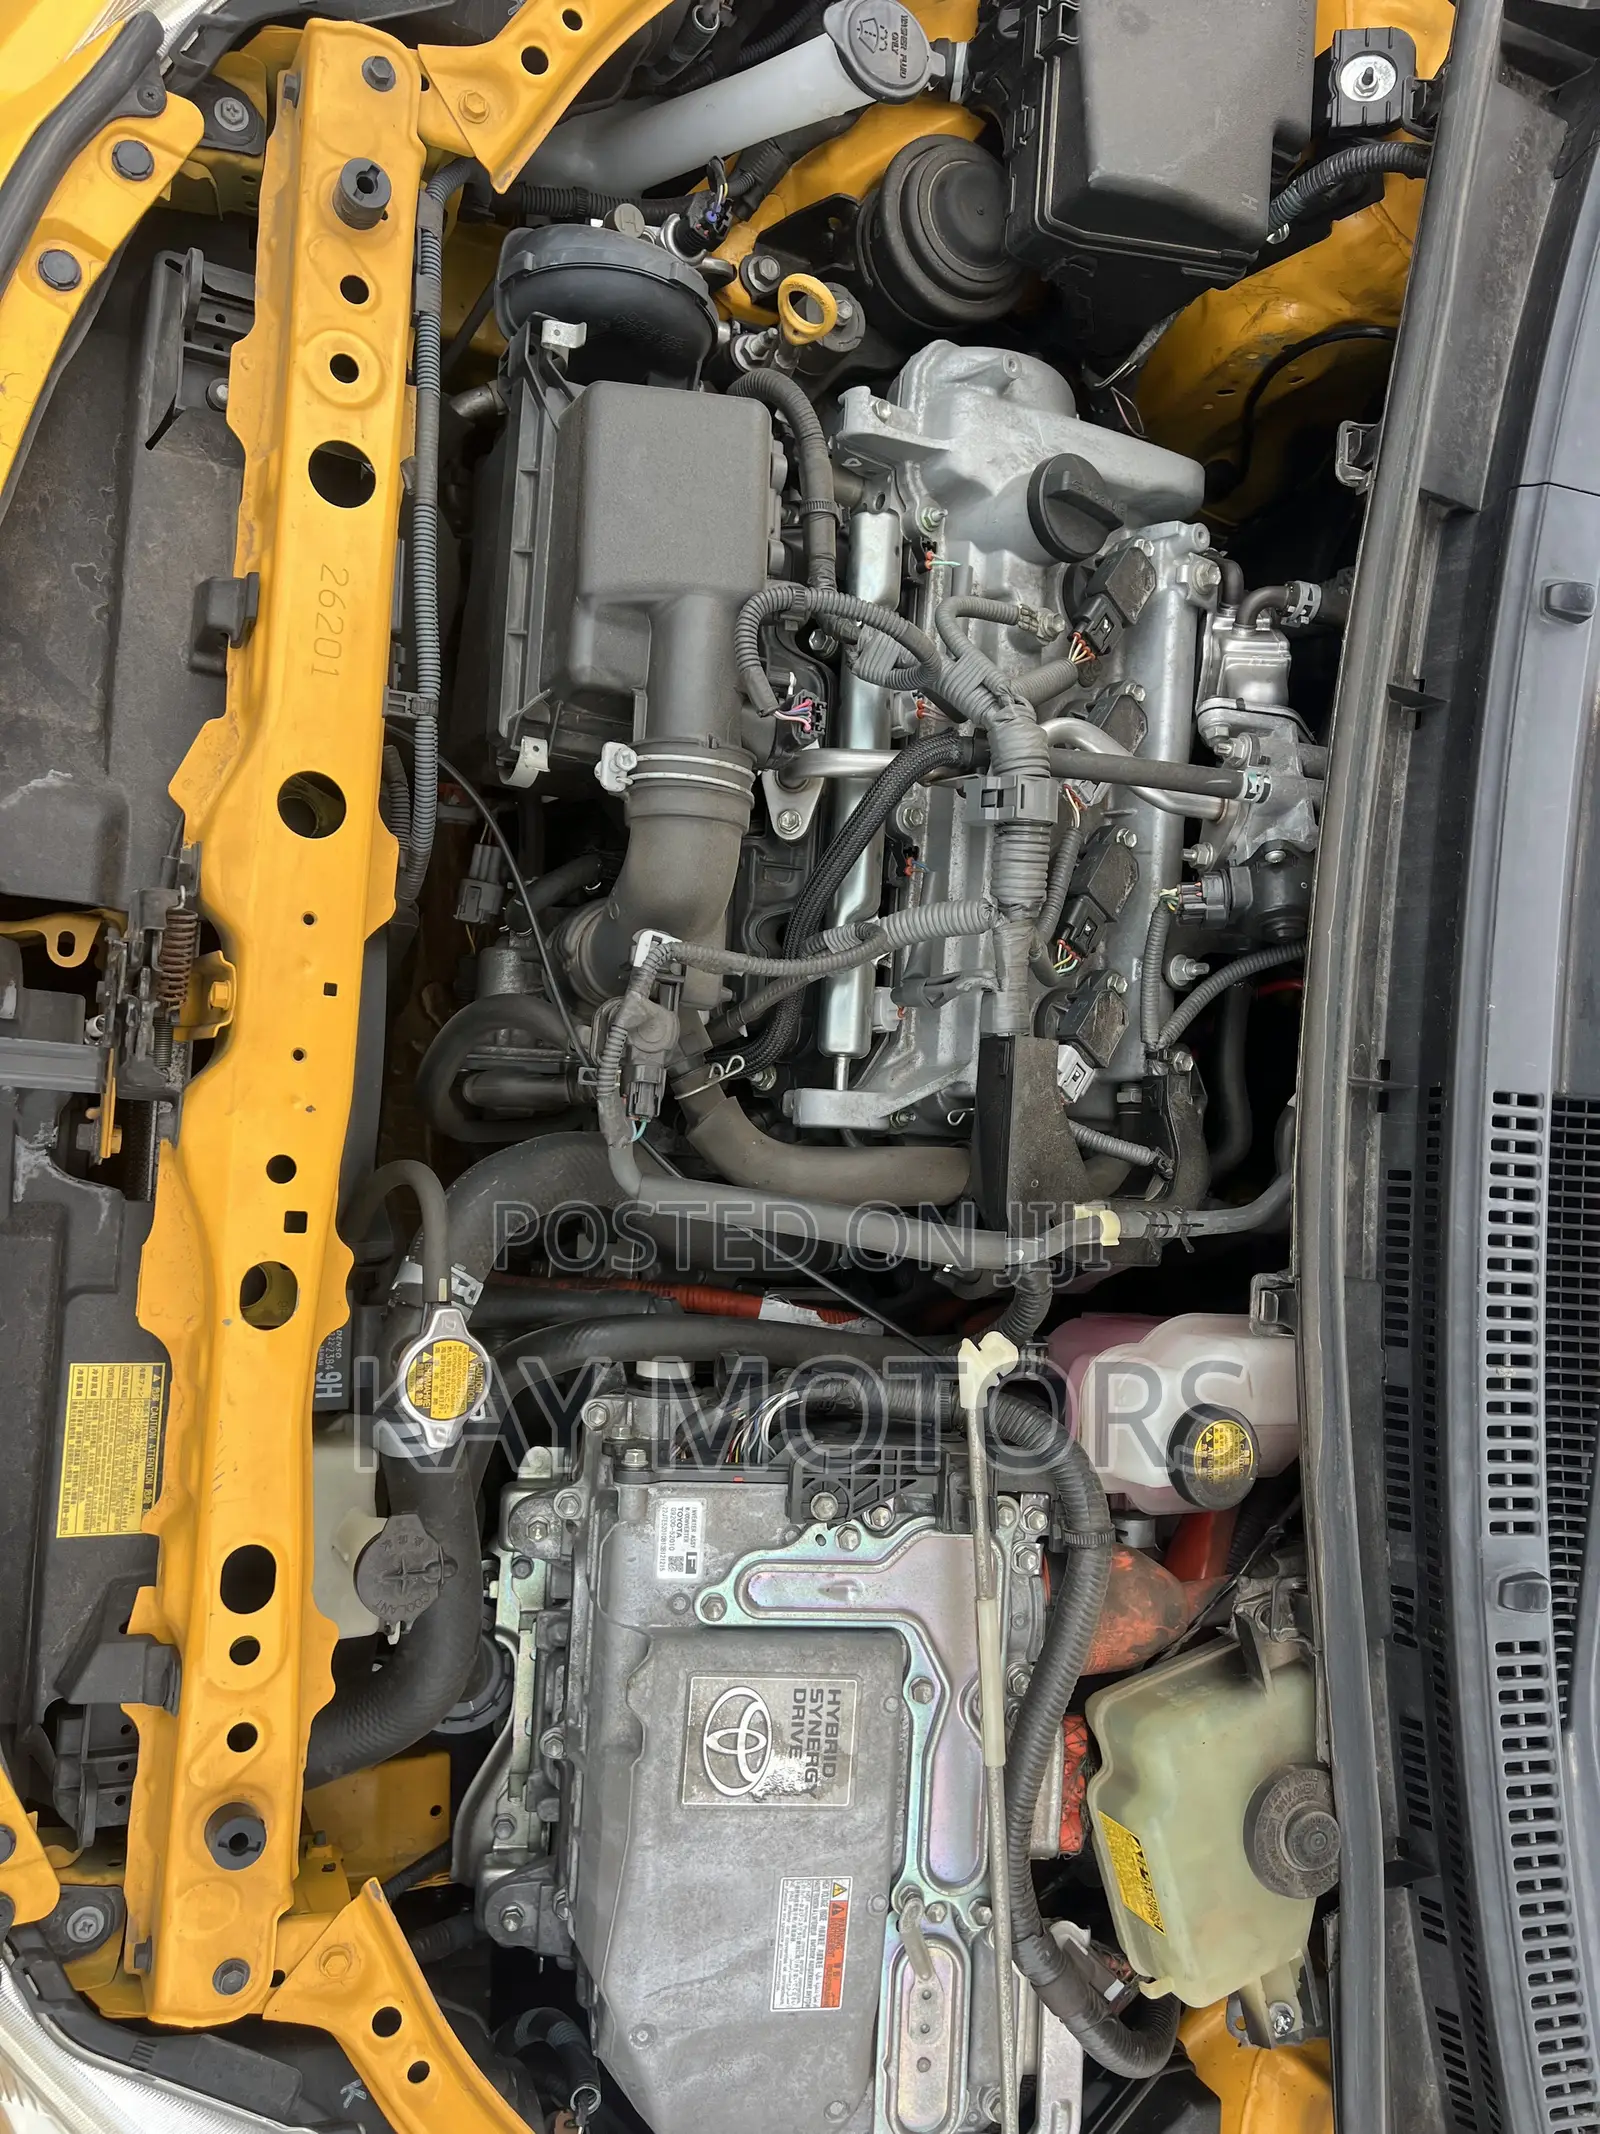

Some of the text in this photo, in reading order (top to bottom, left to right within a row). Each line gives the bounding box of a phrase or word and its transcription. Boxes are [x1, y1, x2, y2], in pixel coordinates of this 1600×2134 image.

[891, 32, 899, 55] ONLY
[899, 15, 909, 79] WASHER FLUID
[310, 563, 350, 677] 26201
[335, 1330, 343, 1359] DENSO
[315, 1372, 343, 1399] 9H
[467, 1362, 476, 1403] ATTENTION
[475, 1362, 484, 1394] CAUTION
[148, 1407, 159, 1439] CAUTION
[145, 1443, 156, 1485] ATTENTION
[668, 1507, 677, 1552] G9200-52010
[371, 1592, 430, 1616] COOLANT
[790, 1688, 807, 1759] DRIVE
[802, 1688, 823, 1800] SYNERGY
[822, 1688, 841, 1778] HYBRID
